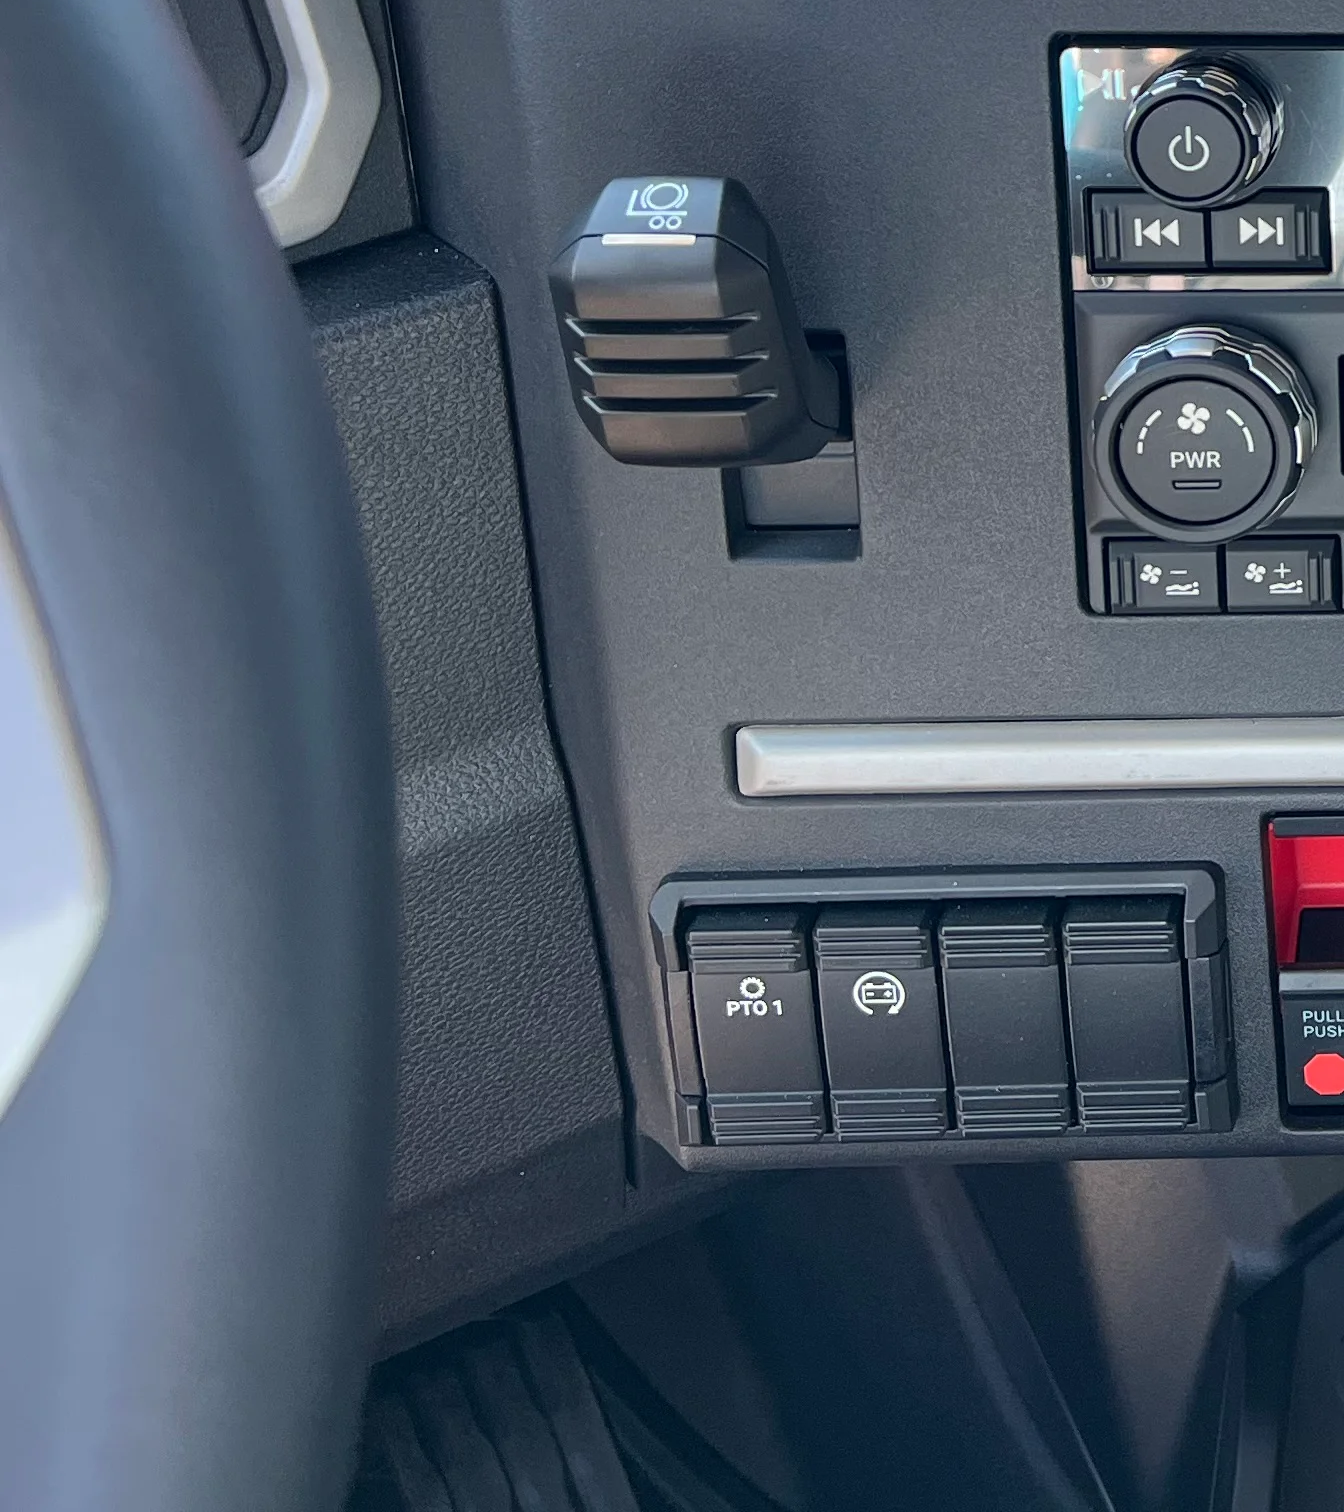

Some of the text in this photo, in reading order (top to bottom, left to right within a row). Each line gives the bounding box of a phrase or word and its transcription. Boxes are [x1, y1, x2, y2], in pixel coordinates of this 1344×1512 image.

[1170, 450, 1222, 469] PWR
[725, 999, 783, 1017] PTO 1
